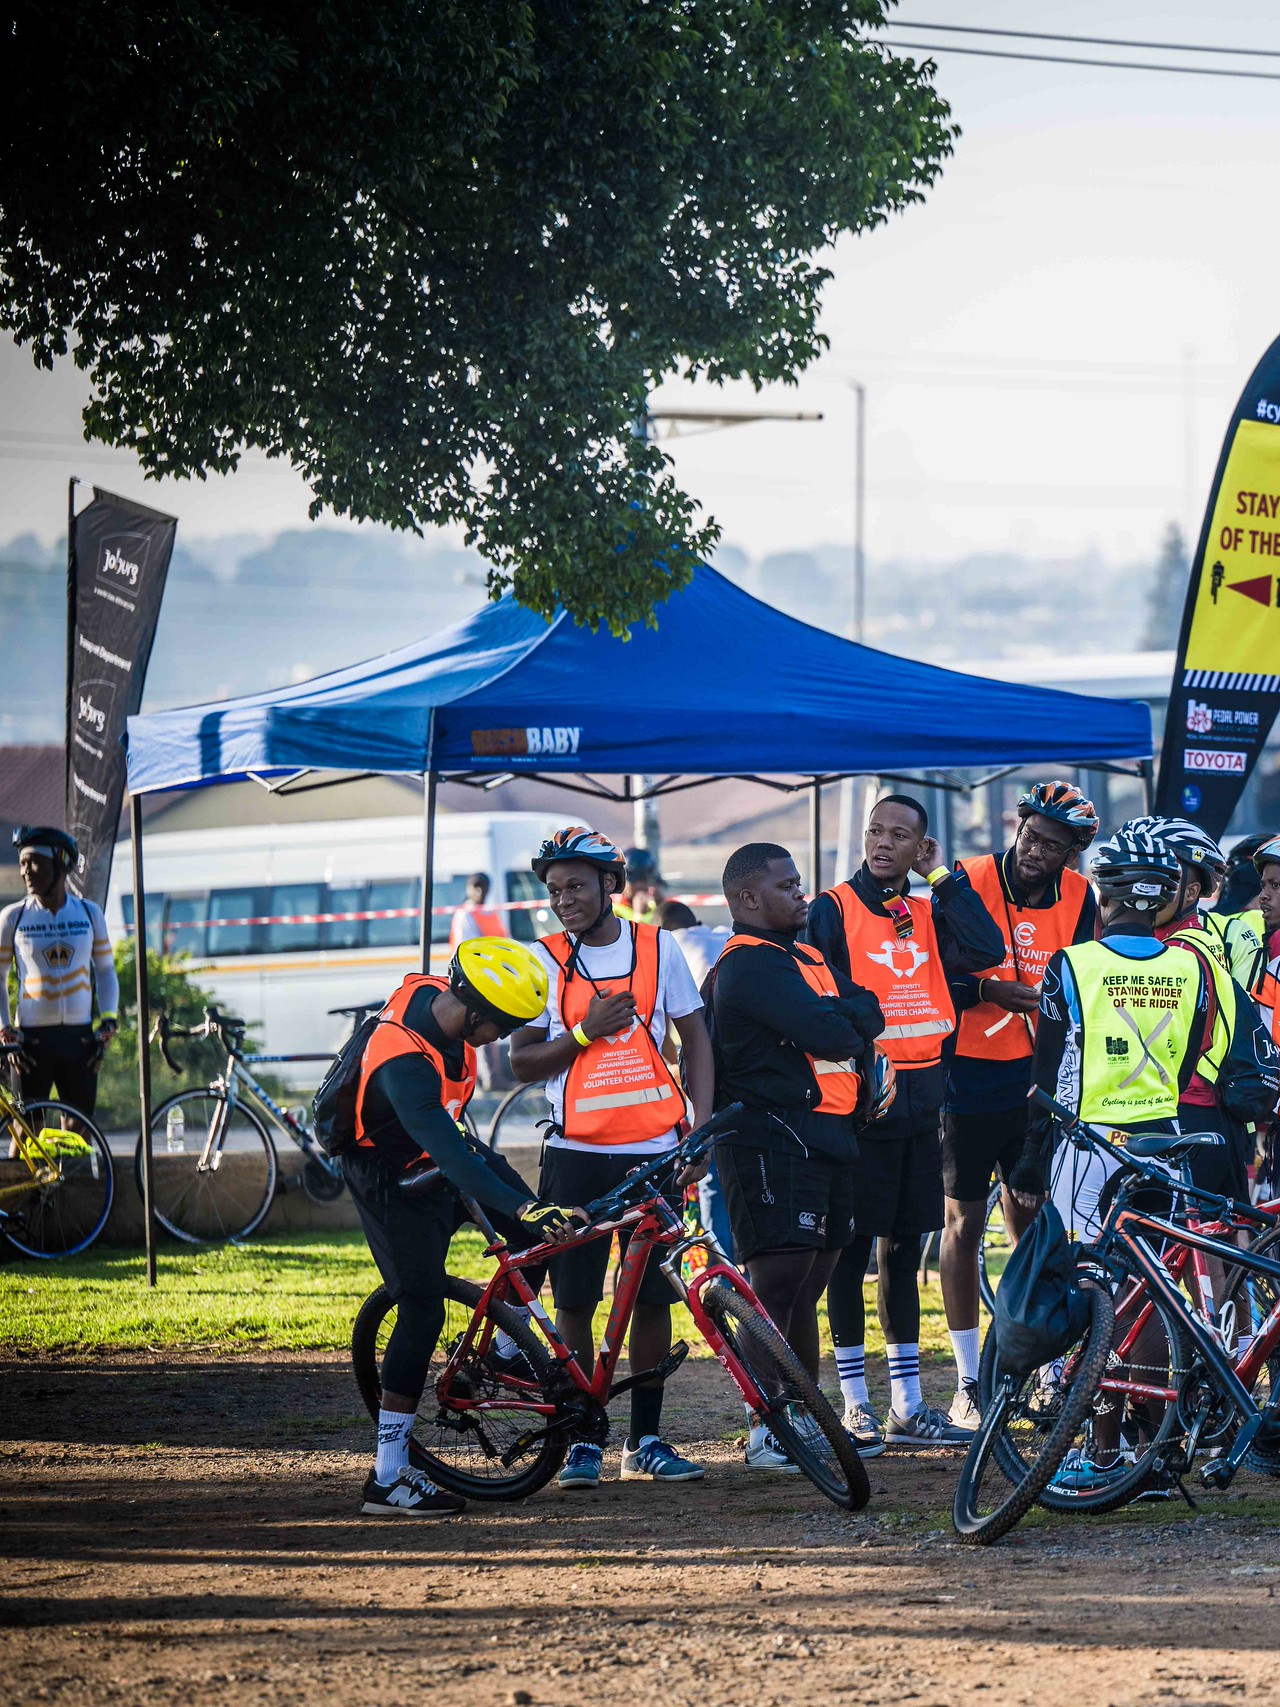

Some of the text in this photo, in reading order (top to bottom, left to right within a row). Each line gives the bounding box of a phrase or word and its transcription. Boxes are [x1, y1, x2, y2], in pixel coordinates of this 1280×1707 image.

[1236, 490, 1280, 519] STAY
[1220, 526, 1244, 551] OF
[1234, 711, 1259, 725] POWER
[1186, 752, 1243, 769] TOYOTA
[1005, 945, 1056, 962] MUNITY
[1102, 976, 1128, 986] KEEP
[1131, 976, 1145, 985] ME
[1148, 976, 1173, 987] SAFE
[1107, 986, 1182, 998] STAYING WIDER
[1113, 998, 1127, 1008] OF
[1149, 999, 1179, 1009] RIDER
[882, 1009, 907, 1018] LUNTEER
[602, 1048, 638, 1058] UNIVERSITY
[596, 1058, 644, 1070] JOHANNESBURG
[588, 1069, 621, 1079] COMMUNITY
[583, 1077, 623, 1089] VOLUNTEER
[1102, 1097, 1126, 1106] Cycling
[1148, 1097, 1153, 1106] of
[1155, 1096, 1163, 1104] the
[1046, 1483, 1079, 1497] CUBIX
